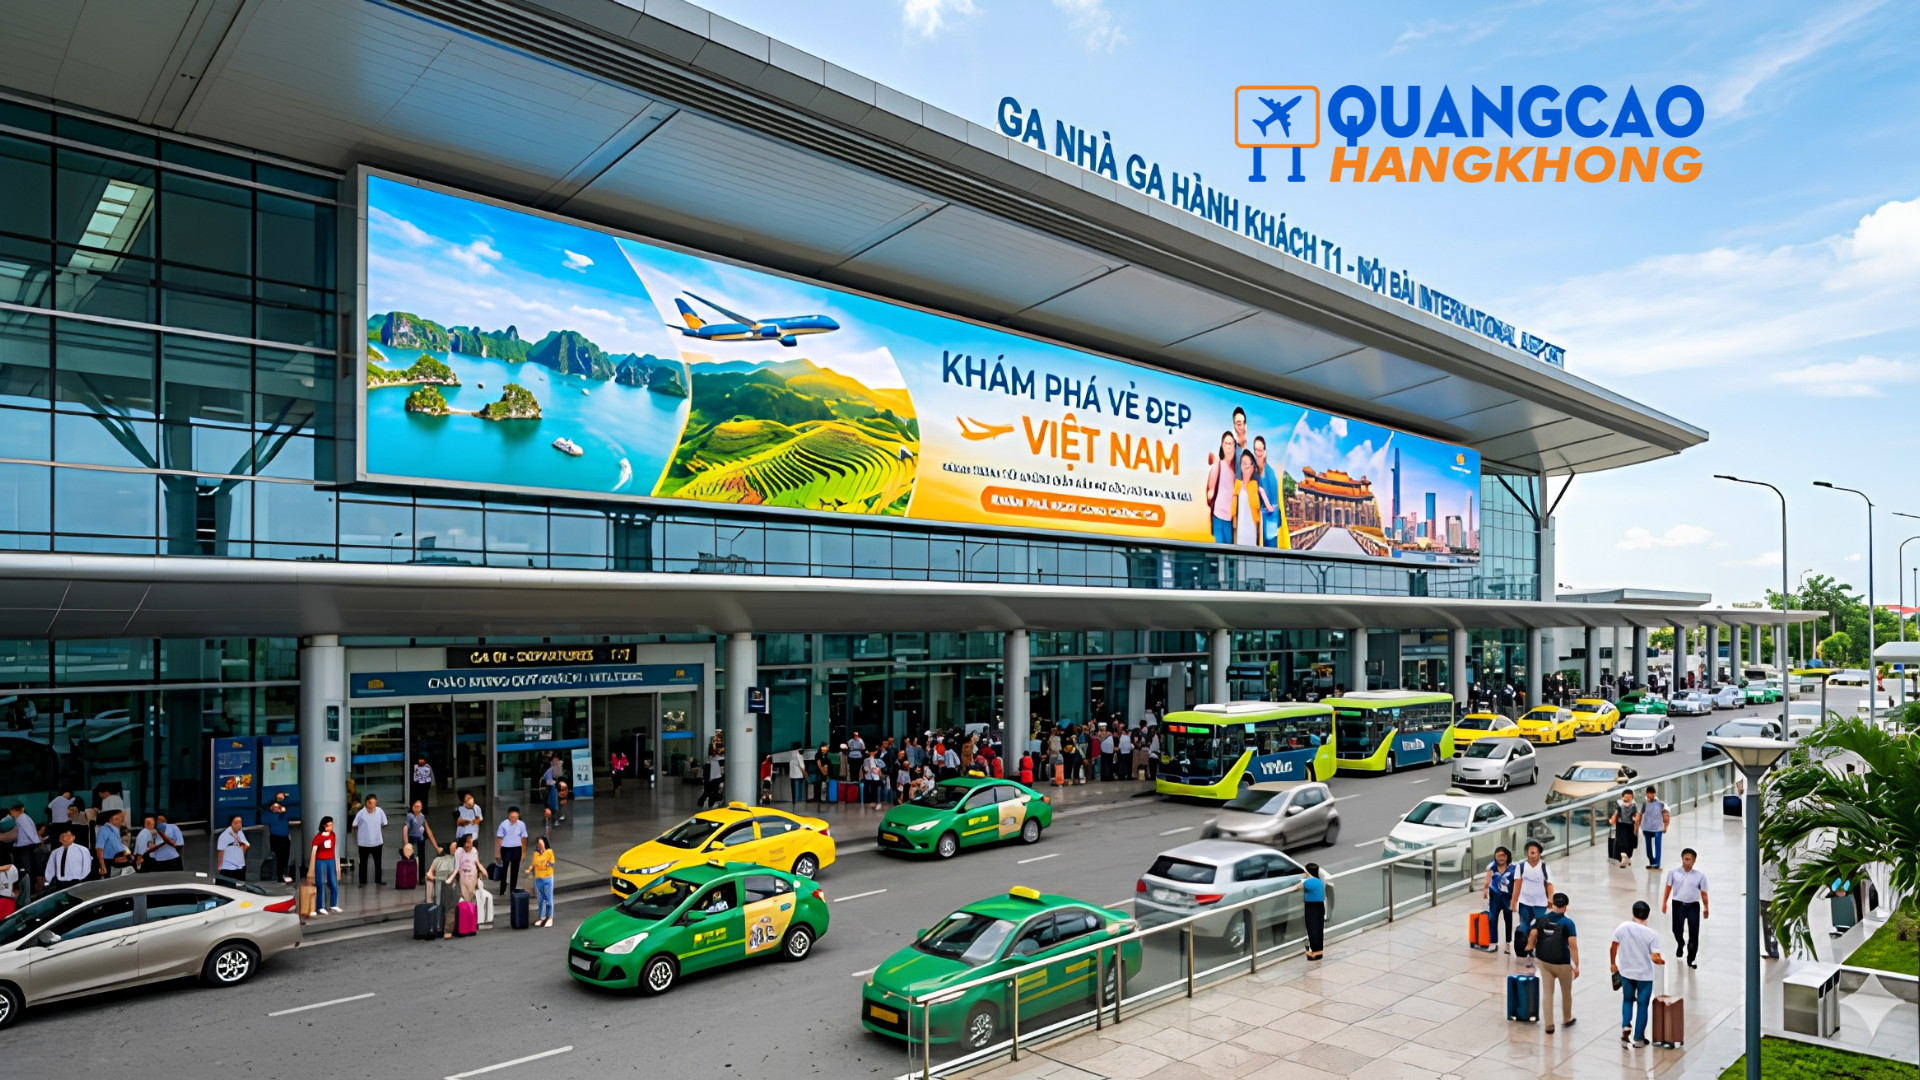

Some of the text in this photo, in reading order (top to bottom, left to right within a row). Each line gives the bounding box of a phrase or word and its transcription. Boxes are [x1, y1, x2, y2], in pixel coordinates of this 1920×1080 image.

[998, 96, 1046, 150] GA
[1055, 119, 1118, 181] NHÀ
[1126, 153, 1166, 201] GA
[1172, 171, 1239, 231] HÀNH
[1245, 205, 1316, 265] KHÁCH
[1321, 239, 1342, 275] T1
[942, 350, 1035, 400] KHÁM
[1045, 373, 1102, 413] PHÁ
[1145, 396, 1193, 434] ĐẸP
[1022, 412, 1180, 476] VIỆT NAM
